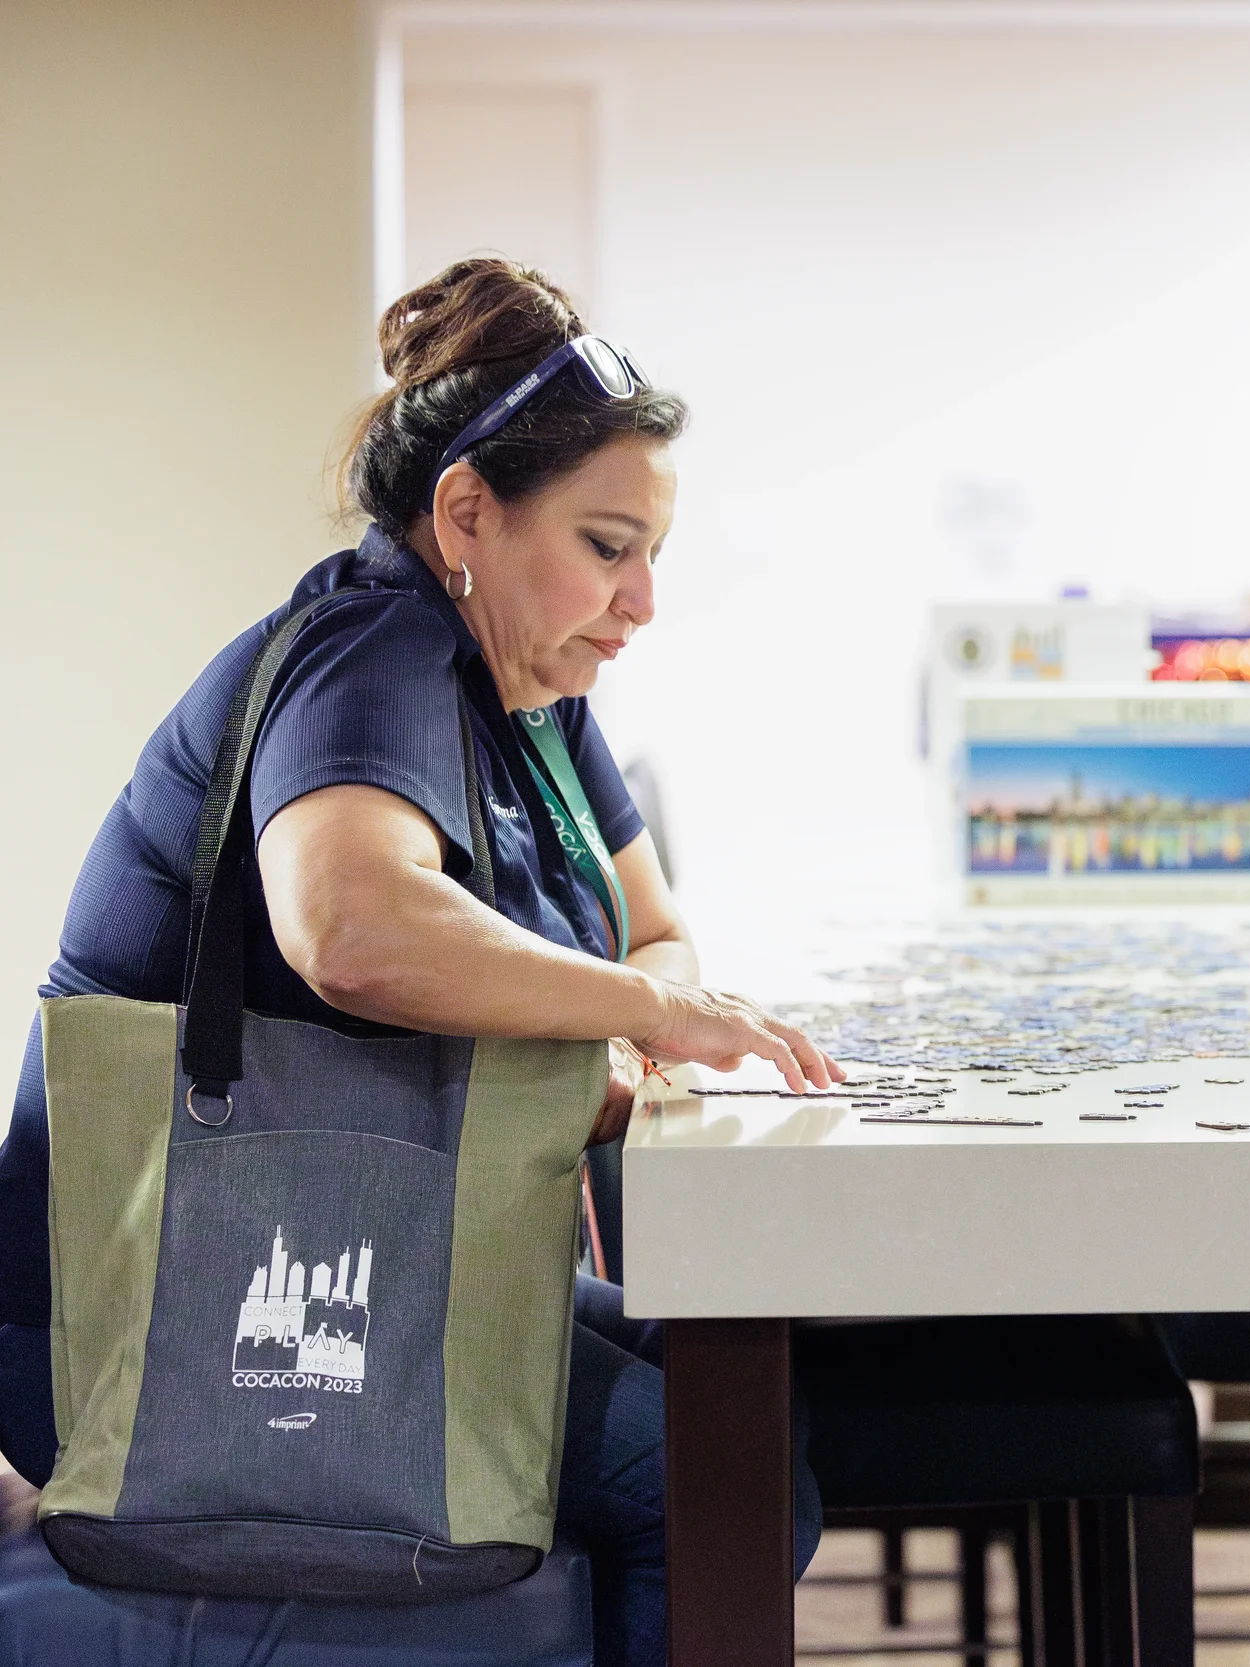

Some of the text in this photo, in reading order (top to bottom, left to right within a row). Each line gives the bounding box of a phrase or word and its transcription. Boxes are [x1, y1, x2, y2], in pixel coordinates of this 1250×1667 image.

[579, 810, 616, 874] COCA
[244, 1306, 303, 1317] CONNECT
[253, 1322, 353, 1354] PLAY
[232, 1373, 363, 1394] COCACON 2023
